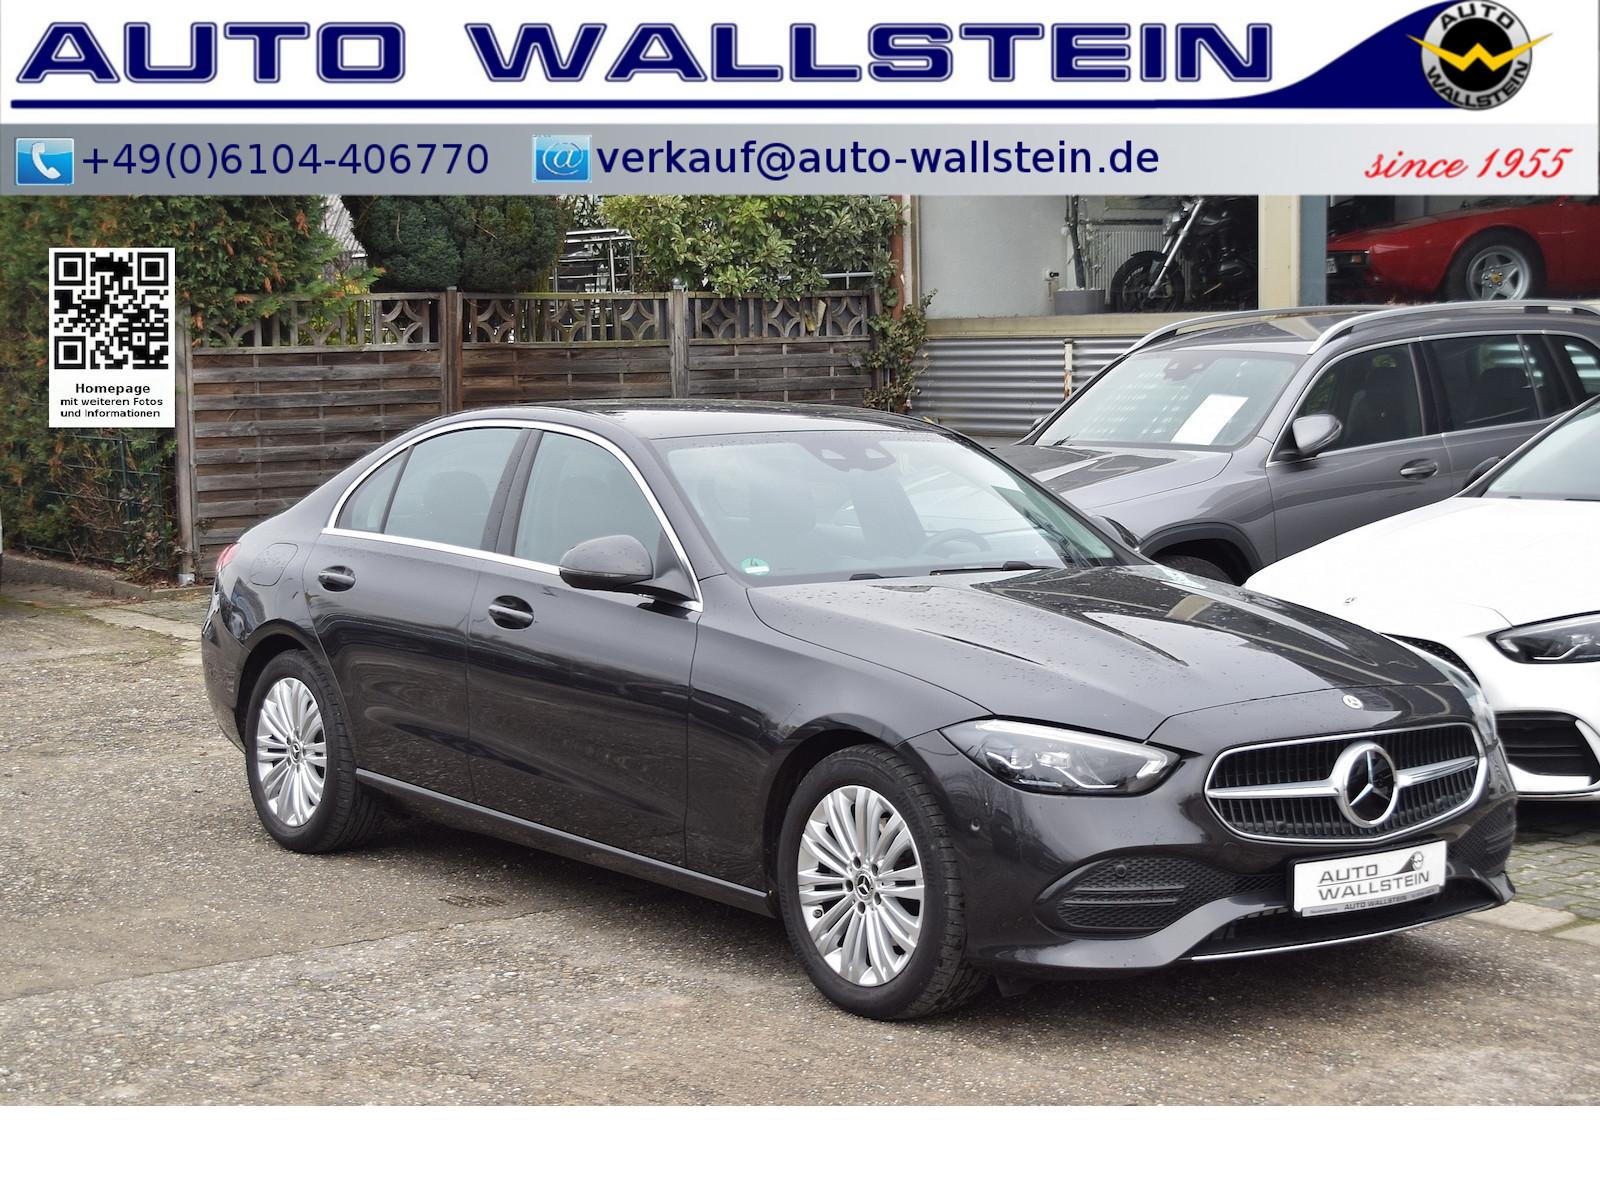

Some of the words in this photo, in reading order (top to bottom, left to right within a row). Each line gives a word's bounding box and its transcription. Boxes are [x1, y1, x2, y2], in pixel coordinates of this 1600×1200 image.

[1319, 864, 1378, 884] AUTO
[1318, 871, 1430, 901] WALLSTEIN
[1344, 902, 1366, 911] AUTO
[1368, 894, 1408, 908] WALLSTEIN
